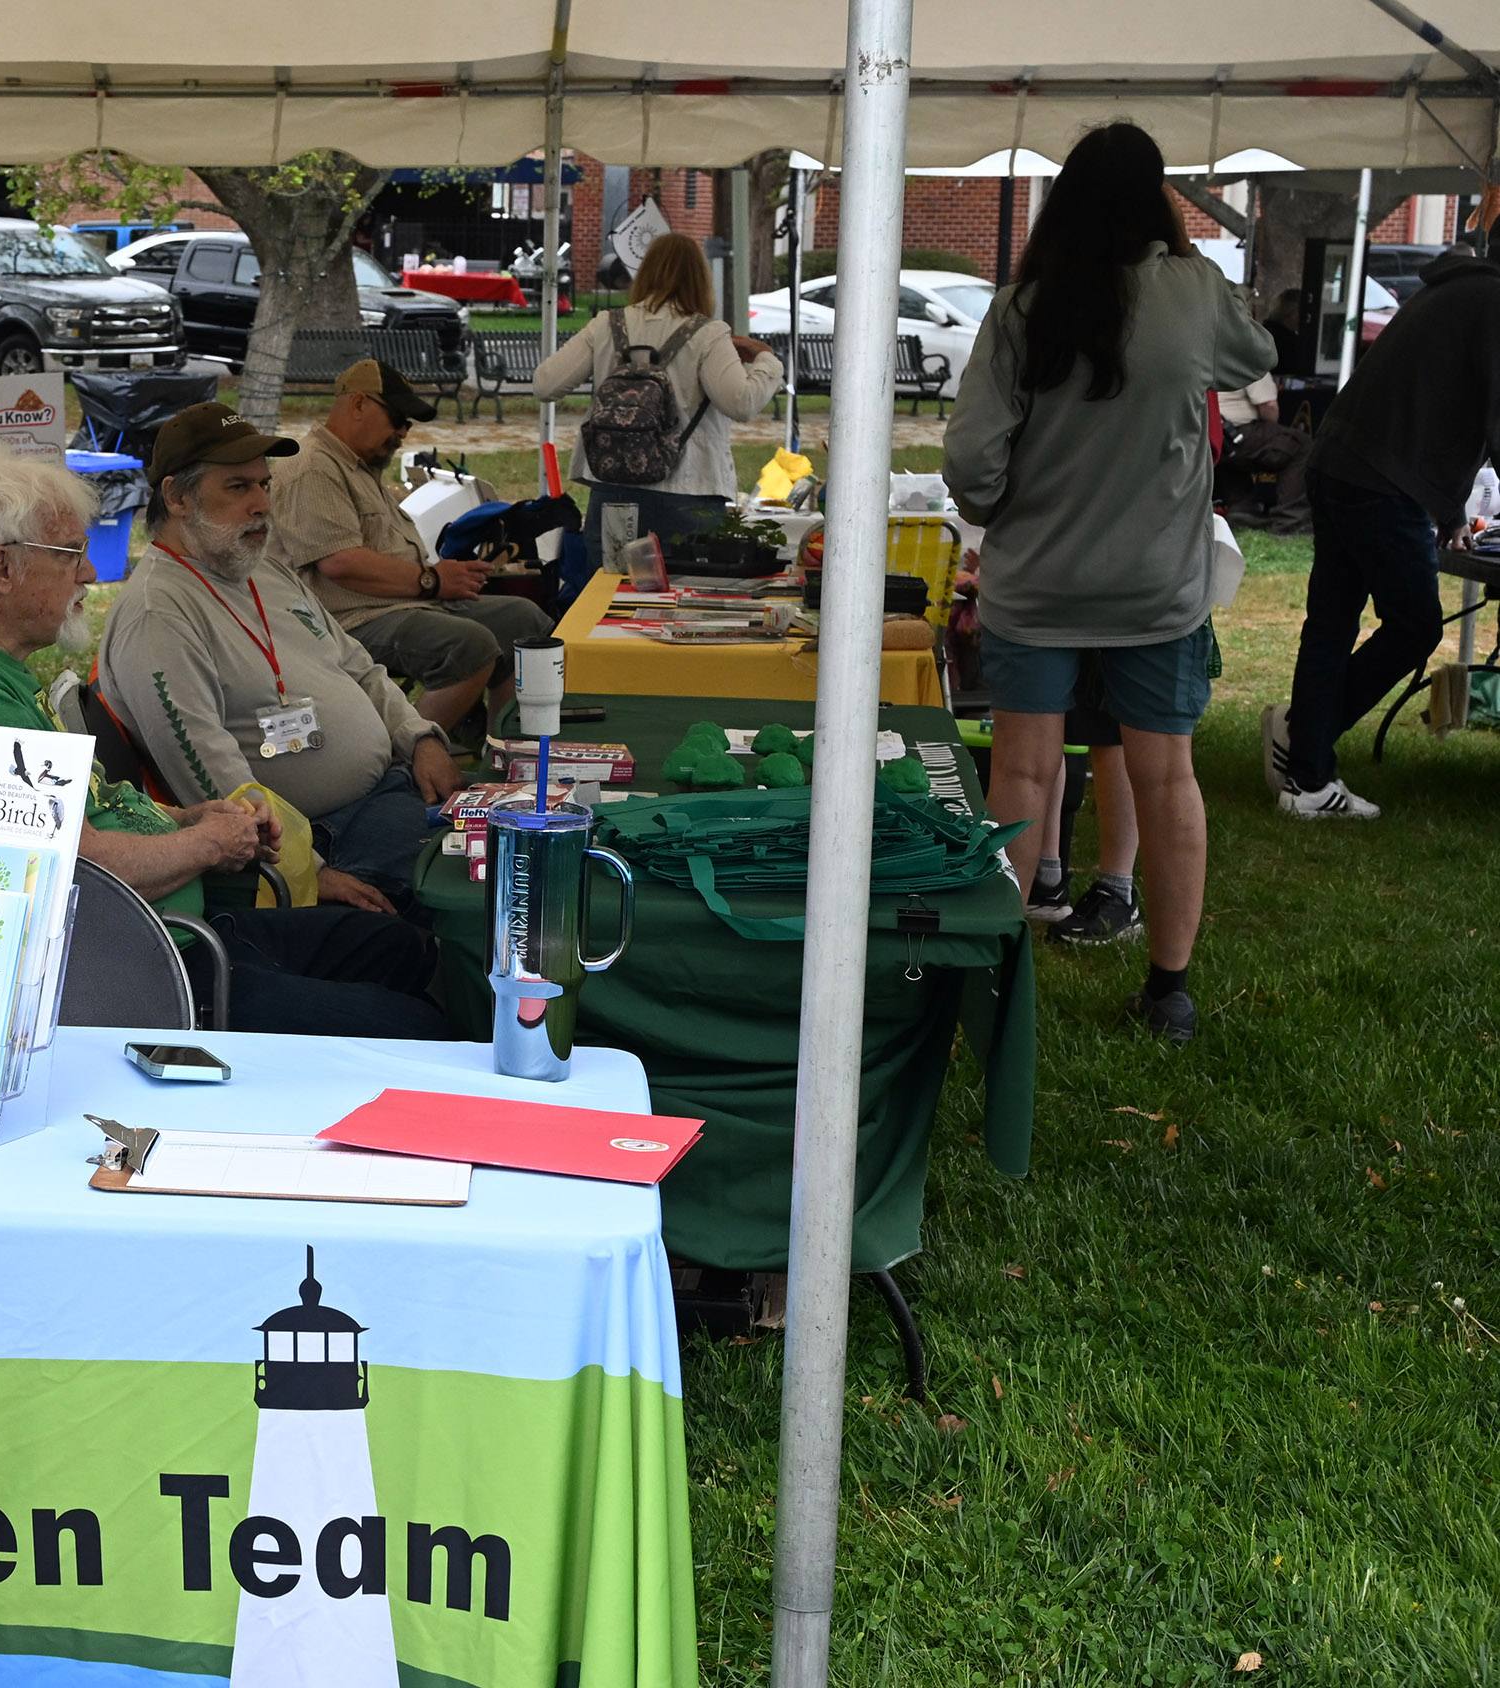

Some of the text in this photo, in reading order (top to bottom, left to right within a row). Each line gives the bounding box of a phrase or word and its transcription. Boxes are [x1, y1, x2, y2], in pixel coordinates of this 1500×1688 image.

[5, 407, 52, 425] Know?
[7, 783, 23, 791] BOLD
[460, 808, 488, 818] Hefty
[159, 1473, 512, 1622] Team
